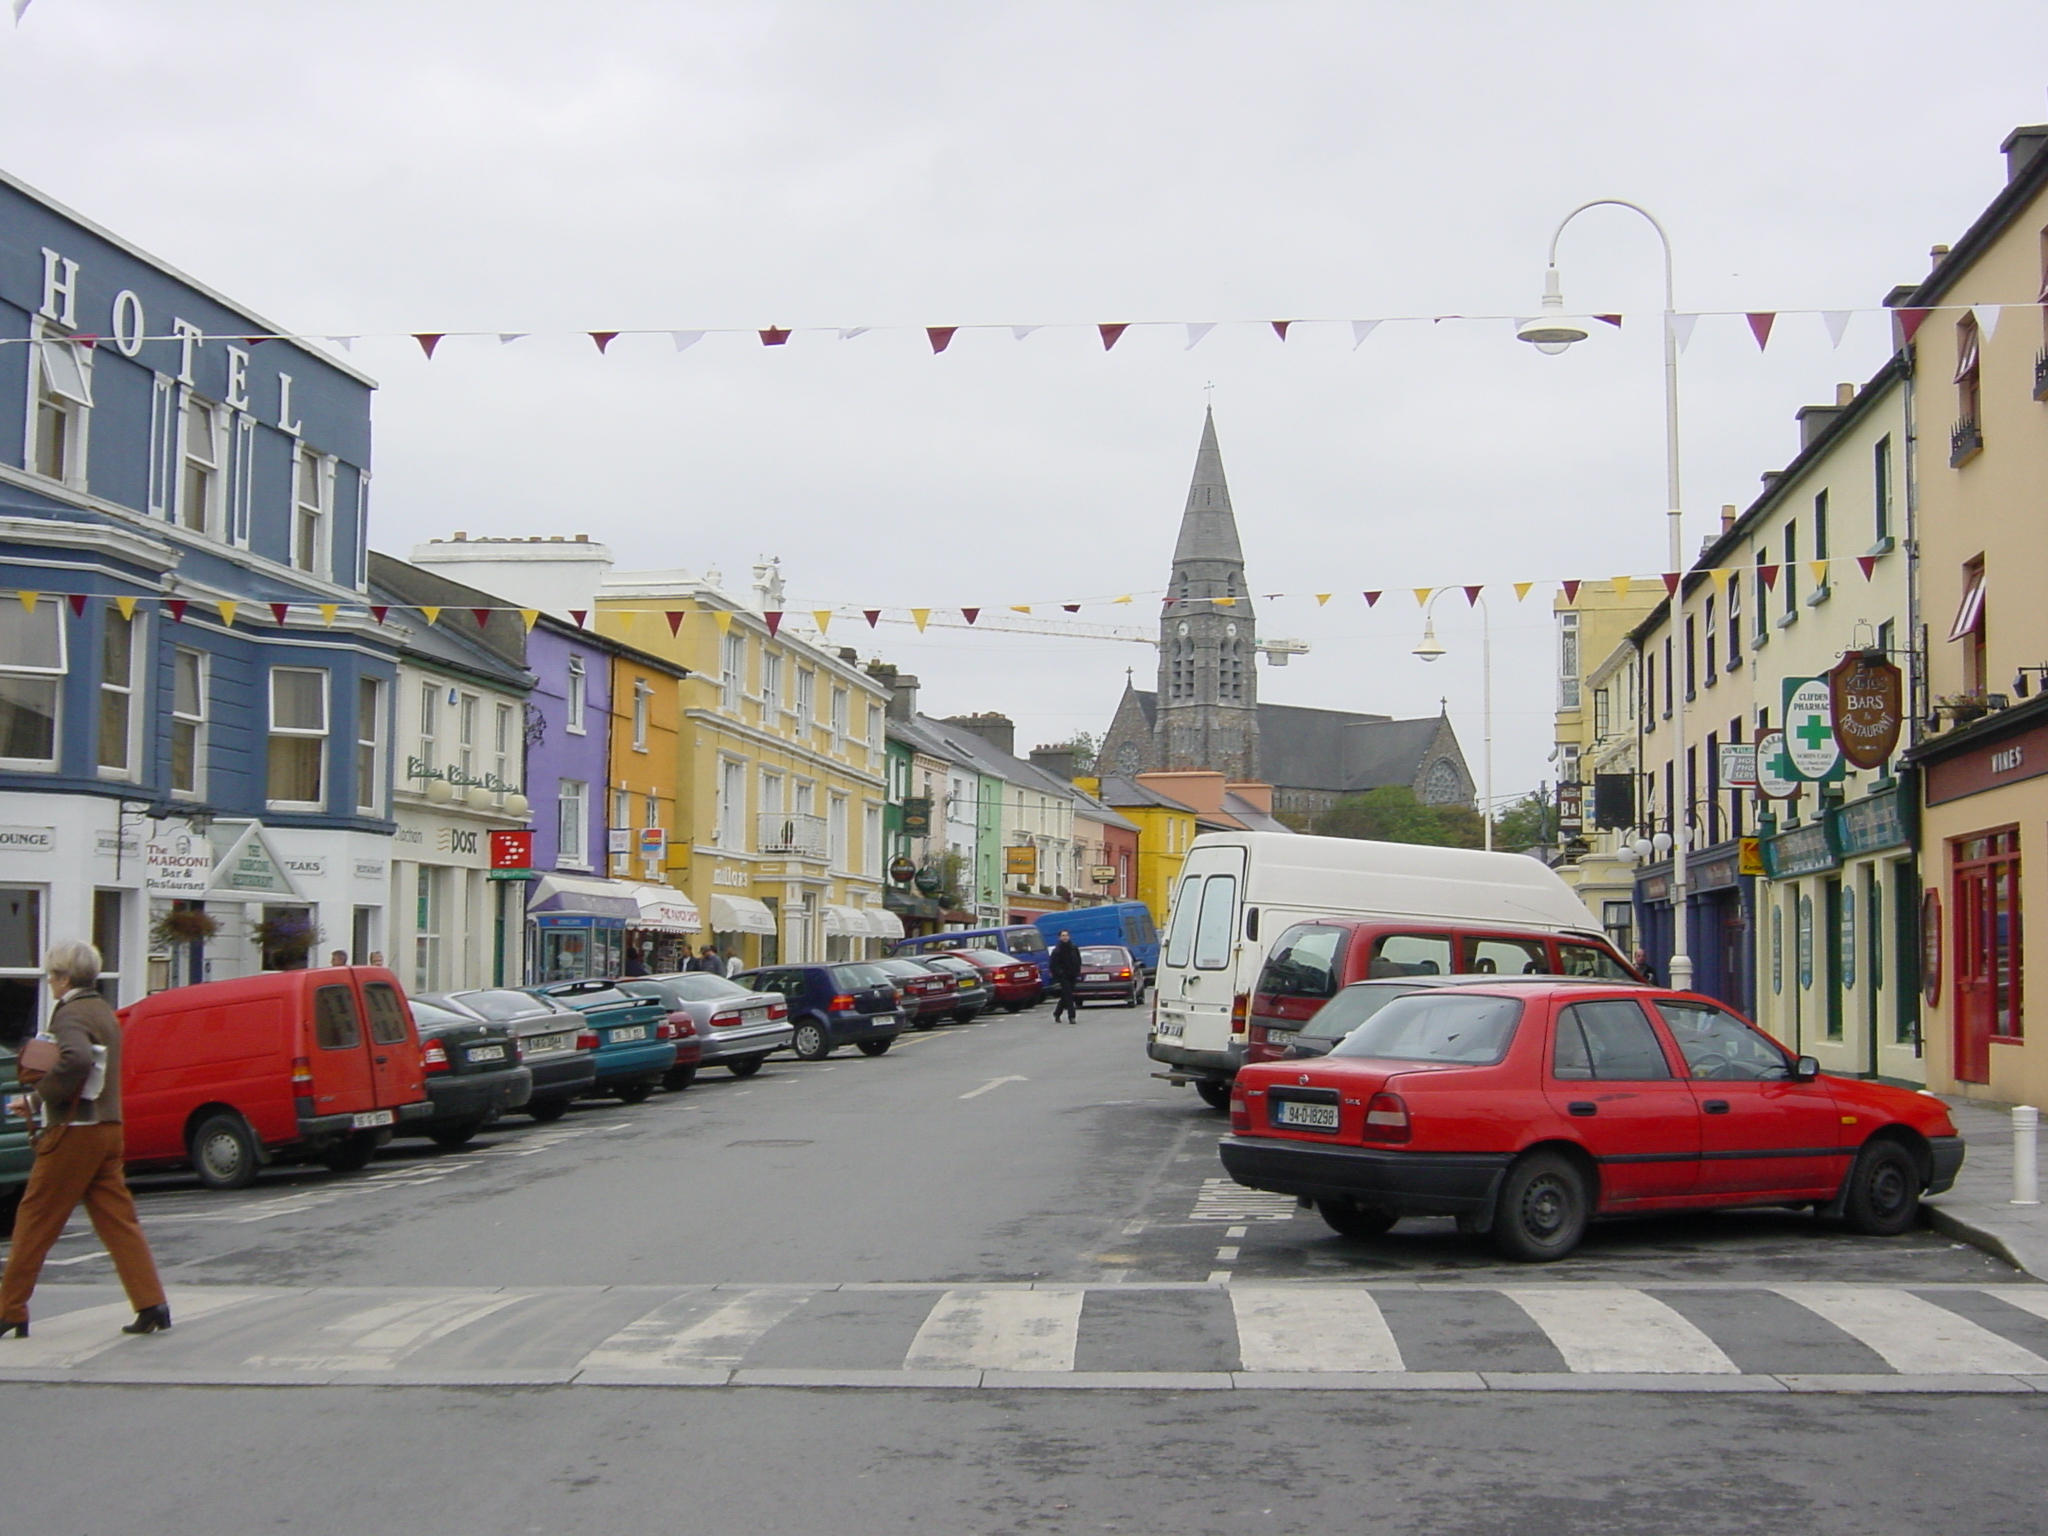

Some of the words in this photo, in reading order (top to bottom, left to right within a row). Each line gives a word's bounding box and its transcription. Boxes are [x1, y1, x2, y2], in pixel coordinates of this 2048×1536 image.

[40, 247, 302, 437] HOTEL
[1798, 693, 1829, 701] CLIFDEN
[1847, 695, 1884, 710] BARS
[1839, 711, 1894, 738] RESTAURANT
[1723, 756, 1736, 779] 1
[146, 844, 169, 855] The
[147, 856, 210, 868] MARCONI
[161, 868, 181, 878] Bar
[183, 868, 194, 878] &
[146, 878, 206, 890] Restaurant
